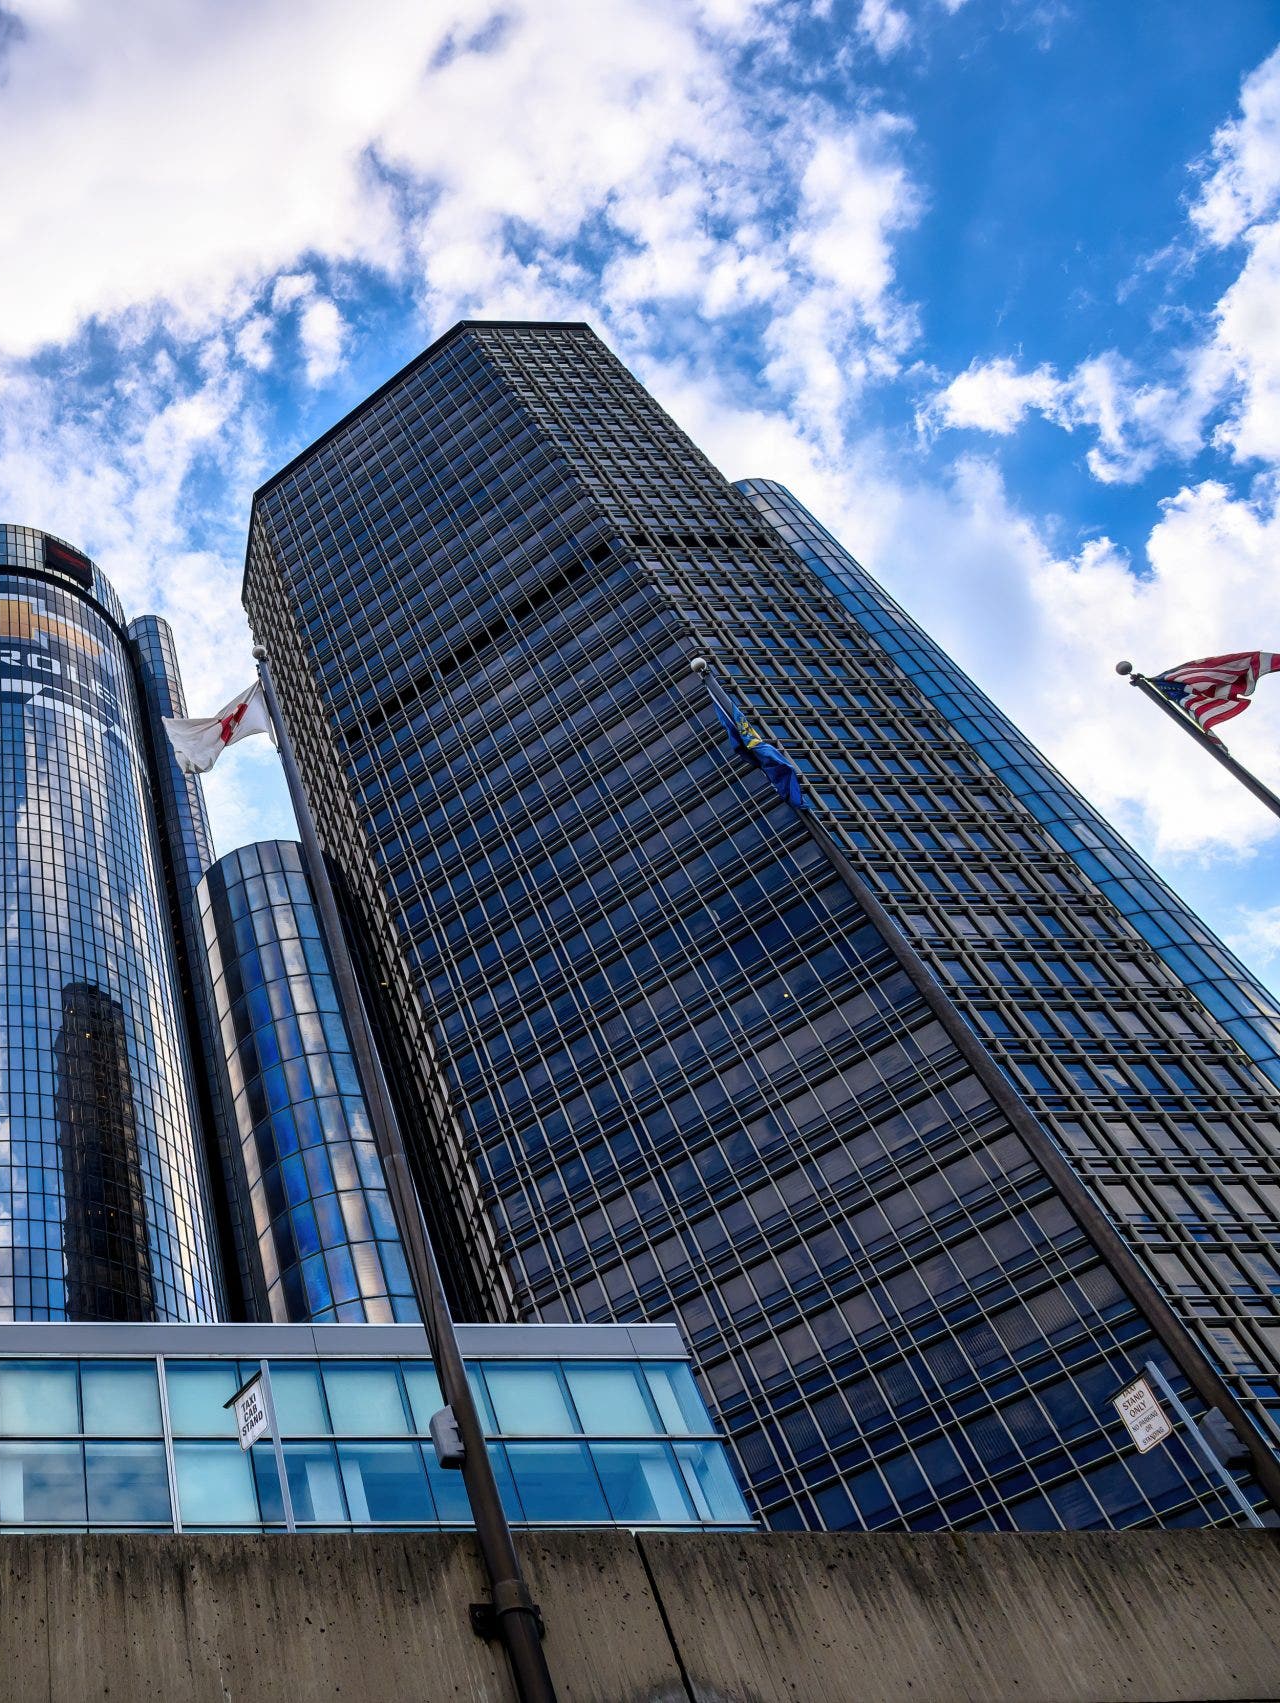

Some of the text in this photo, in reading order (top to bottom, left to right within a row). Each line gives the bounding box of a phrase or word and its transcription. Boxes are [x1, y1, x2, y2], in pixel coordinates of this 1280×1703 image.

[241, 1393, 256, 1412] TAXI
[1122, 1390, 1144, 1410] STAND
[1130, 1400, 1146, 1417] ONLY
[244, 1404, 257, 1422] CAB
[1131, 1410, 1158, 1432] NO PARKING
[242, 1410, 263, 1436] STAND
[1145, 1424, 1153, 1432] OR
[1142, 1427, 1164, 1445] STANDING
